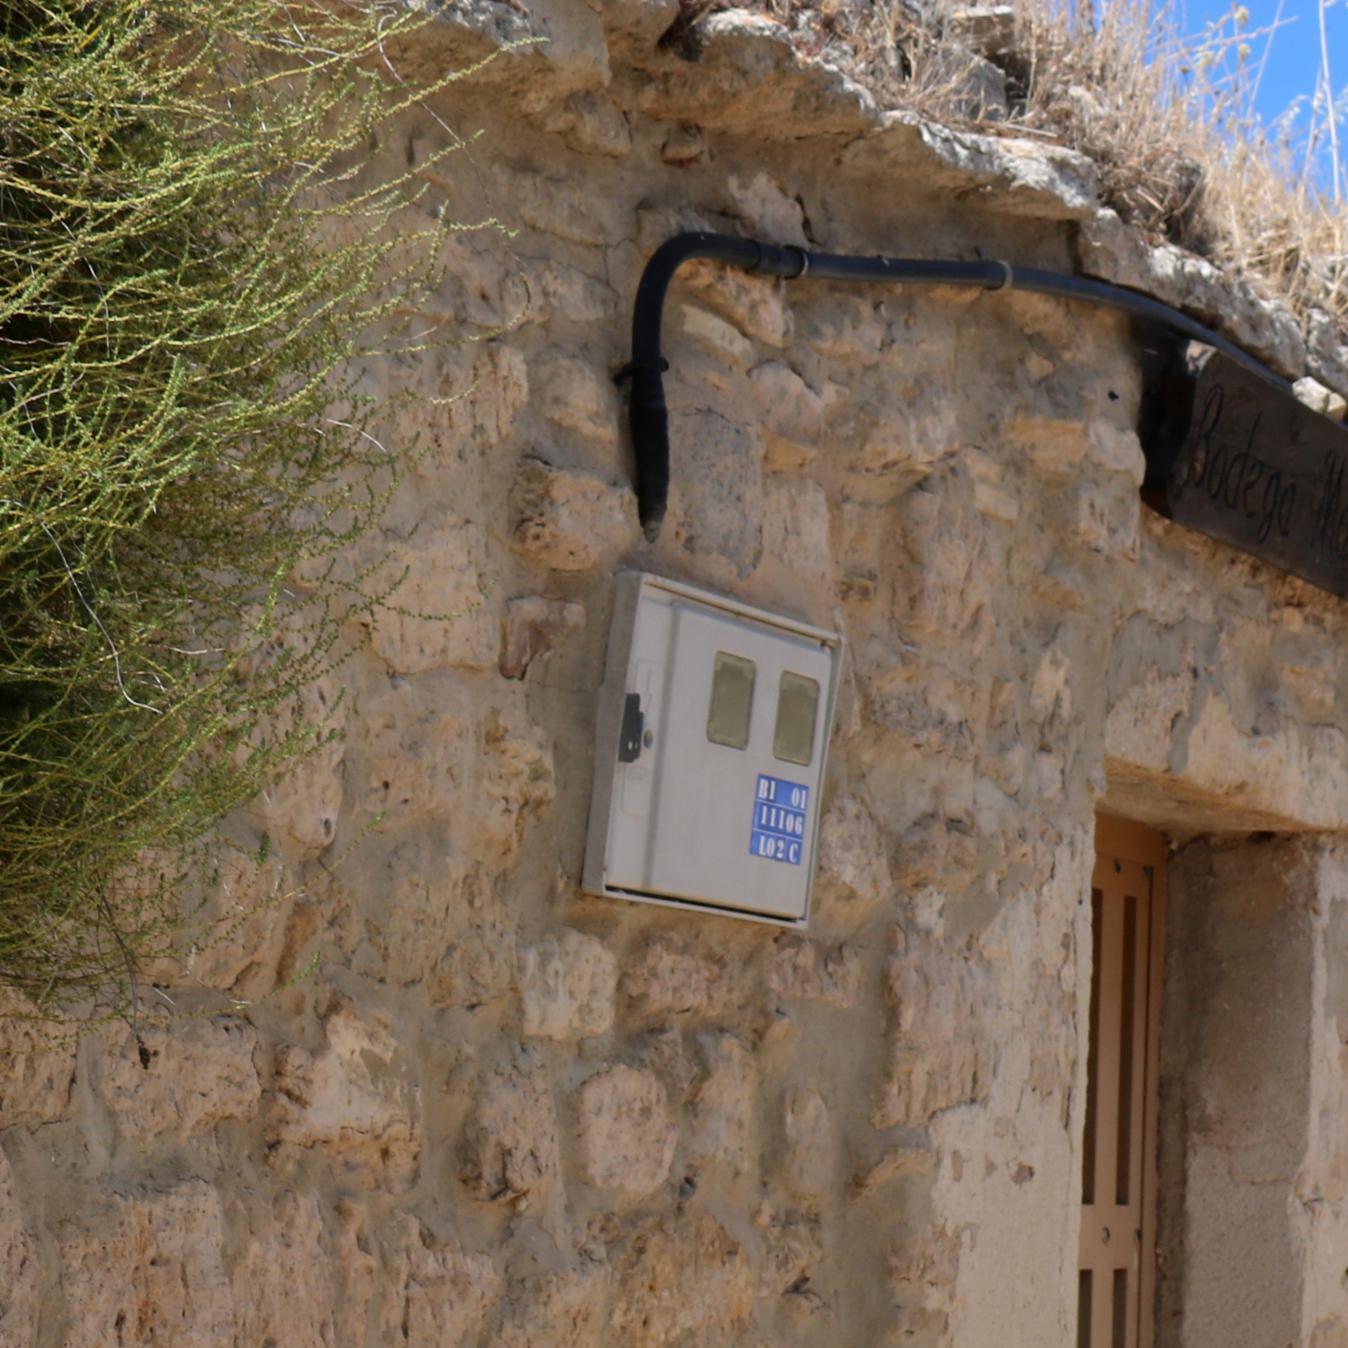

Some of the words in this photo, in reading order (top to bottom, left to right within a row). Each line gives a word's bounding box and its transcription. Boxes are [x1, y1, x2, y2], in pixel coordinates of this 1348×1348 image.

[1171, 383, 1298, 546] Bodega
[791, 787, 807, 809] 01
[760, 805, 803, 835] 11106
[788, 843, 799, 864] C
